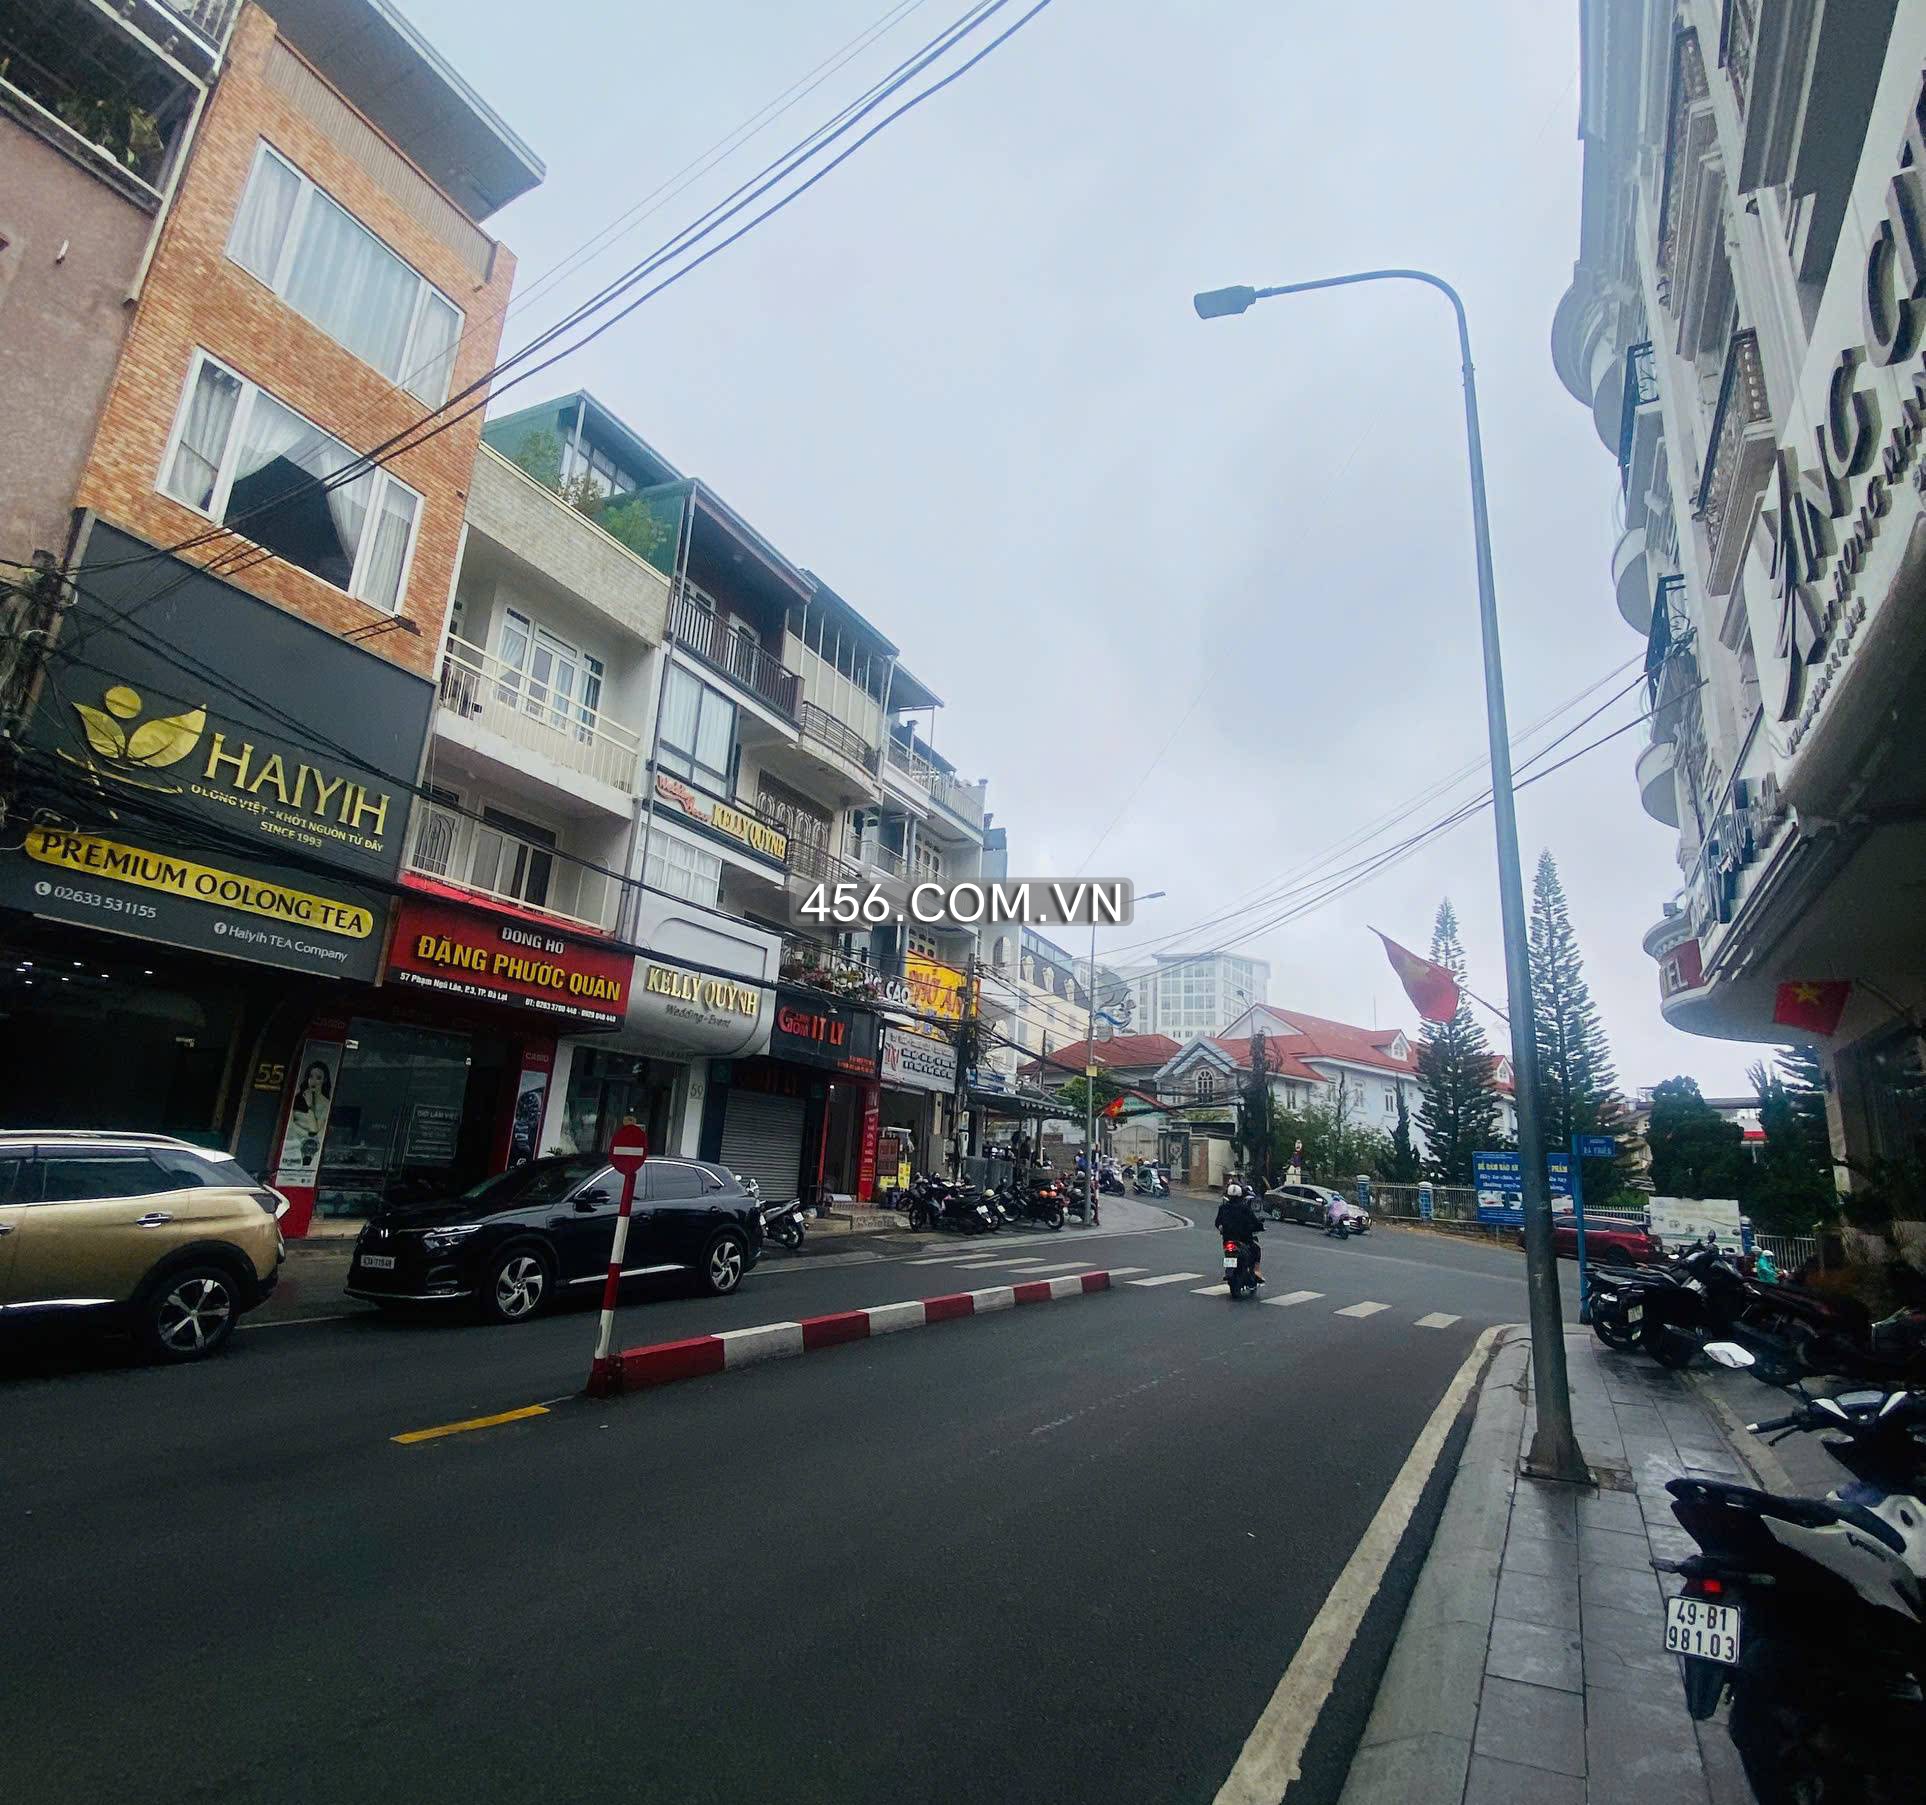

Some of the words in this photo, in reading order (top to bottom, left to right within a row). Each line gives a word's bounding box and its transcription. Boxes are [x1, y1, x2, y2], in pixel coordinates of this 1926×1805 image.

[204, 733, 391, 835] HAIYIH
[260, 821, 296, 839] SINCE
[297, 832, 322, 848] 1993
[40, 832, 188, 889] PREMIUM
[195, 873, 312, 920] OOLONG
[320, 905, 362, 933] TEA
[54, 886, 101, 906] 02633
[229, 926, 267, 944] Haiyih
[270, 935, 292, 950] TEA
[294, 941, 348, 962] Company
[400, 972, 410, 981] 57
[411, 975, 432, 986] Phạm
[418, 935, 487, 971] ĐẶNG
[493, 954, 566, 989] PHƯỚC
[569, 974, 620, 1001] QUÂN
[646, 965, 701, 1003] KELLY
[255, 1063, 284, 1084] 55
[1677, 1601, 1728, 1632] 49-B1
[1668, 1625, 1735, 1661] 981.03
